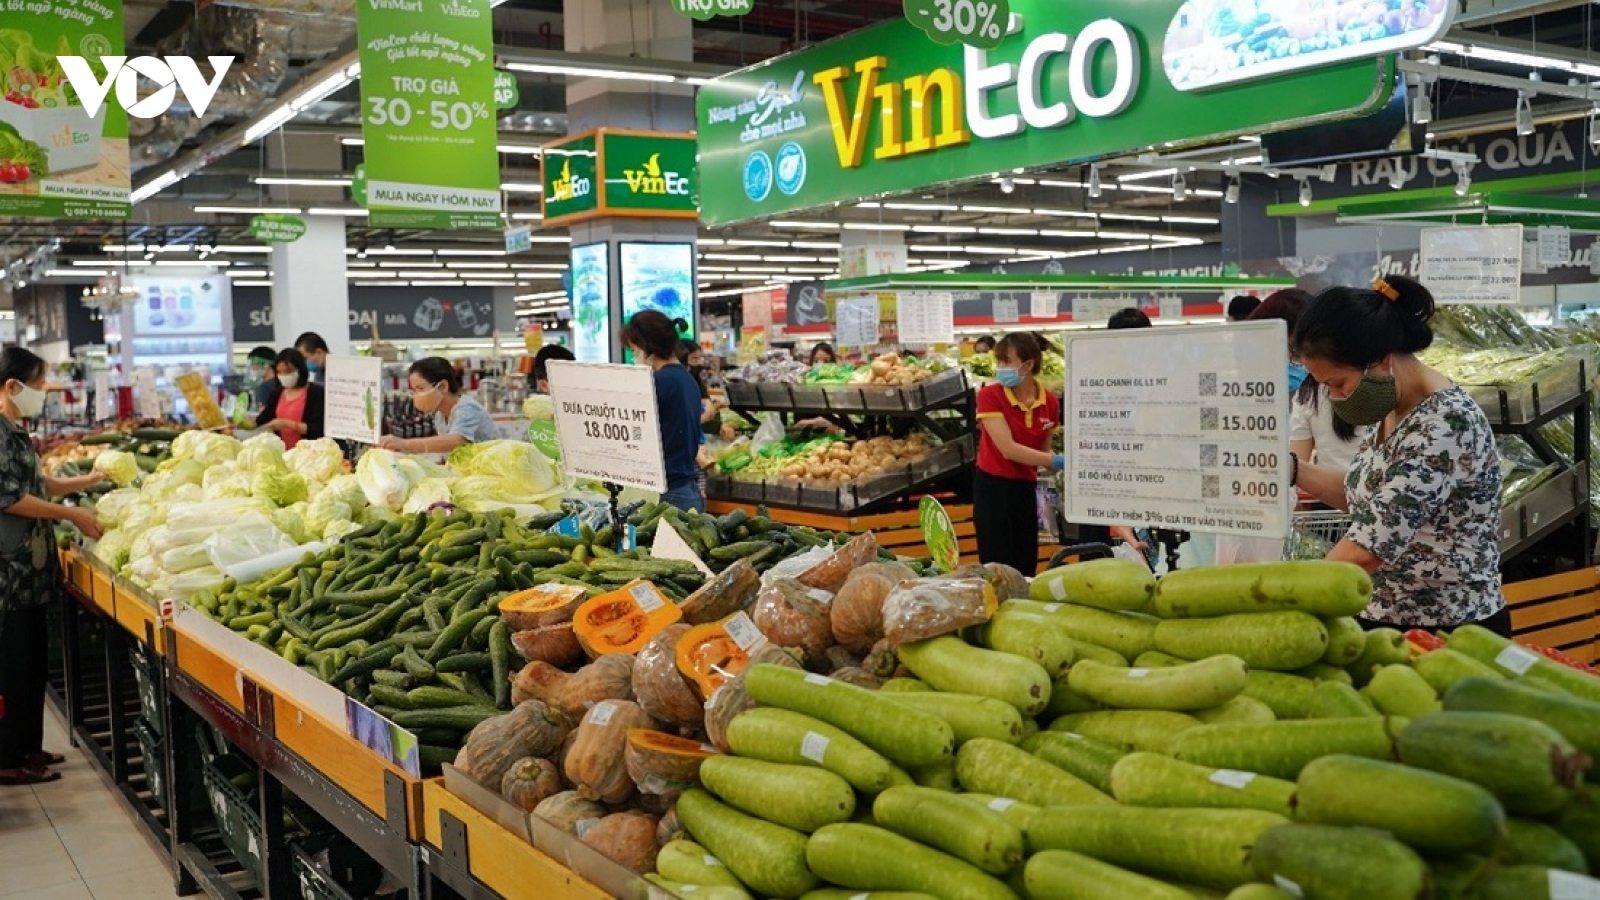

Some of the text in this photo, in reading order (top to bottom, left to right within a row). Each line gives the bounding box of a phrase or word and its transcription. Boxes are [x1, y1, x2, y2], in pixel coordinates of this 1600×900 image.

[392, 75, 460, 97] TRỢ GIÁ
[368, 96, 412, 127] 30
[1485, 121, 1575, 170] QUẢ
[375, 190, 495, 208] MUA NGAY HÔM NAY
[1156, 377, 1168, 386] MT
[1222, 381, 1275, 397] 20.500
[584, 402, 616, 421] CHUỘT
[632, 409, 647, 422] MT
[583, 420, 630, 442] 18.000
[1222, 415, 1277, 431] 15.000
[1133, 443, 1144, 451] MT
[1222, 452, 1278, 469] 21.000
[1231, 480, 1279, 497] 9.000
[1087, 507, 1105, 518] TÍCH
[1145, 511, 1163, 522] 3%
[1165, 514, 1181, 524] GIÁ
[1236, 521, 1263, 531] VINID
